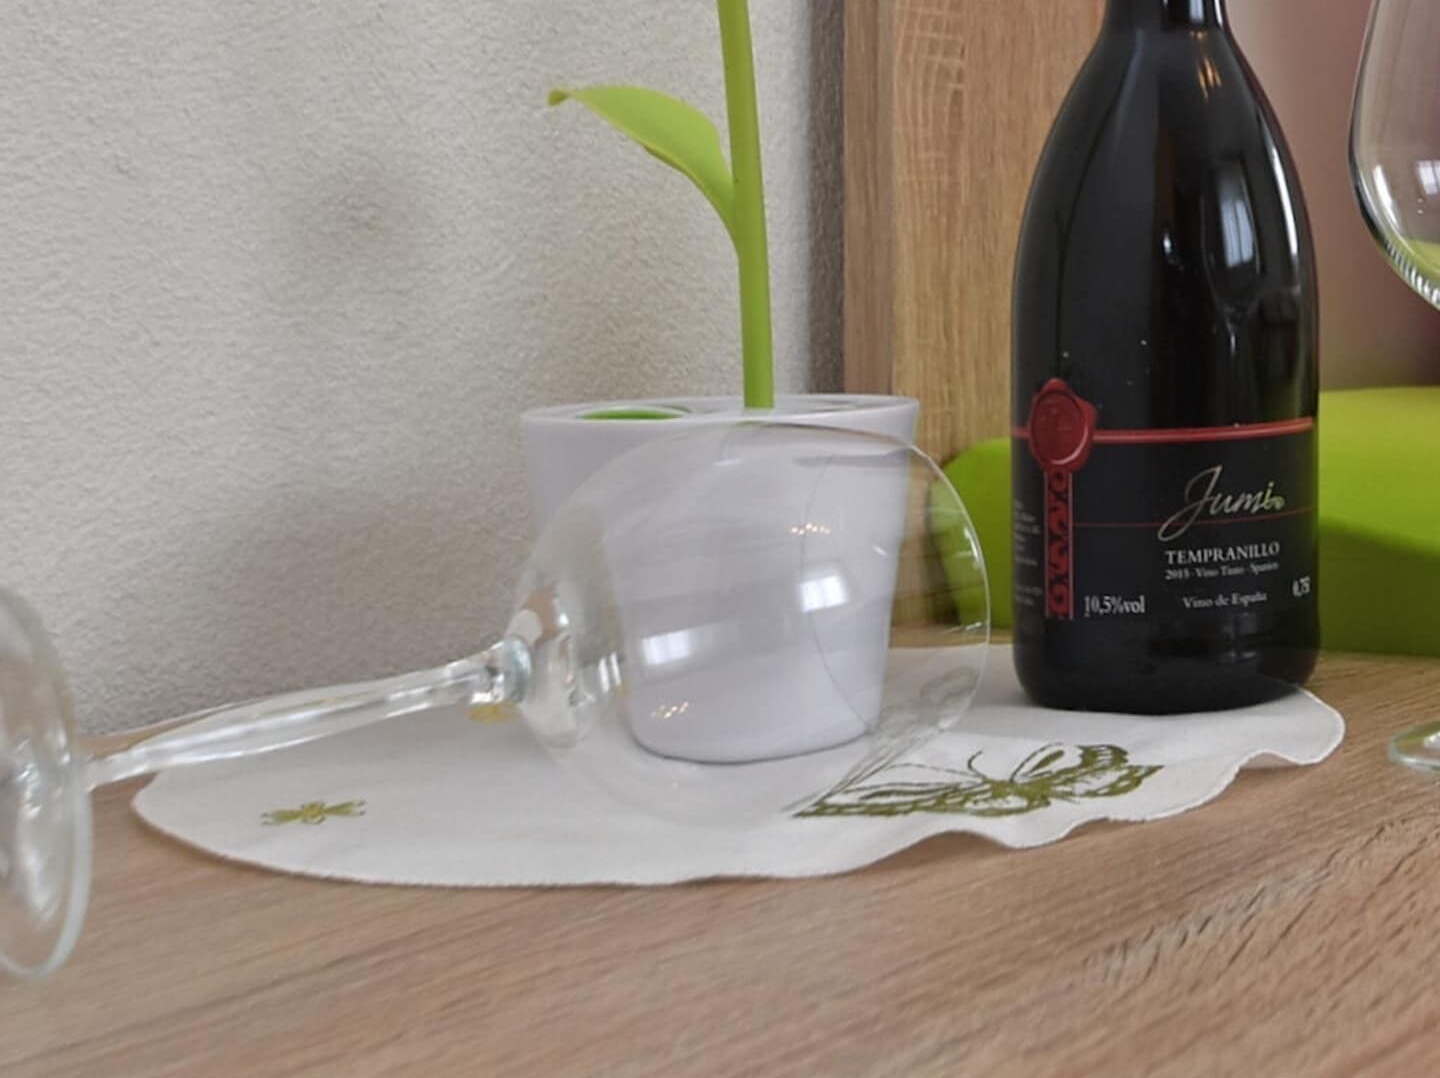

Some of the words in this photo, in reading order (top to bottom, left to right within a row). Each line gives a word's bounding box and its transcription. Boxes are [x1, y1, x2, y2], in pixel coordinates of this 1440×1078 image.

[1164, 541, 1280, 565] TEMPRANILLO
[1182, 596, 1213, 609] Vino
[1215, 593, 1229, 606] de
